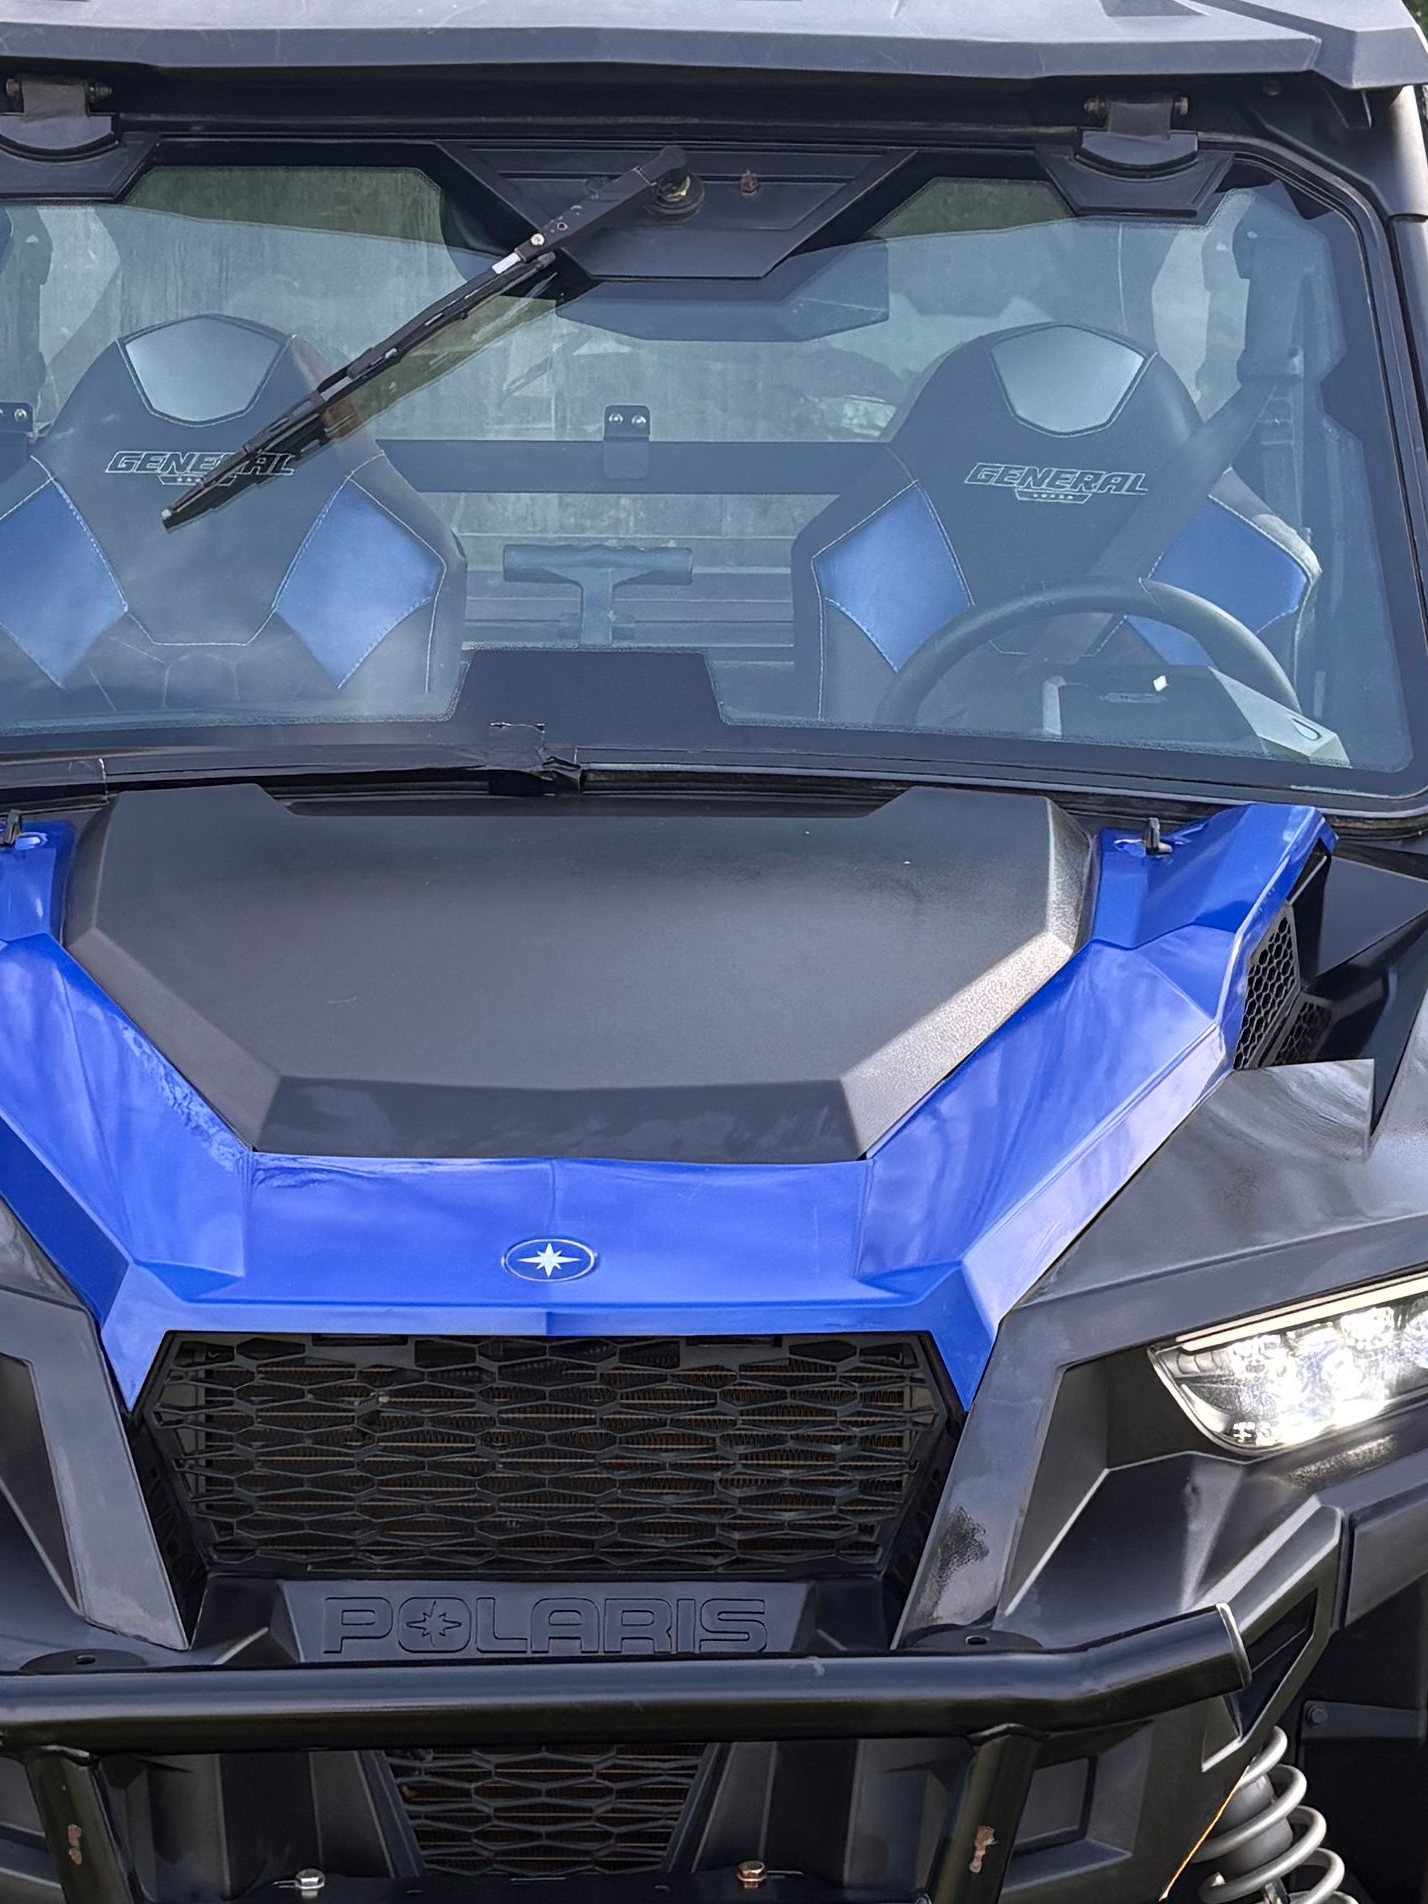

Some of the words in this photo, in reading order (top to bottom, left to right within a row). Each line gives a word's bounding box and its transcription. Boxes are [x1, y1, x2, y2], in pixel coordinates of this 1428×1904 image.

[105, 451, 295, 476] GENEAL
[964, 462, 1149, 496] GENERAL
[323, 1596, 768, 1655] POLARIS
